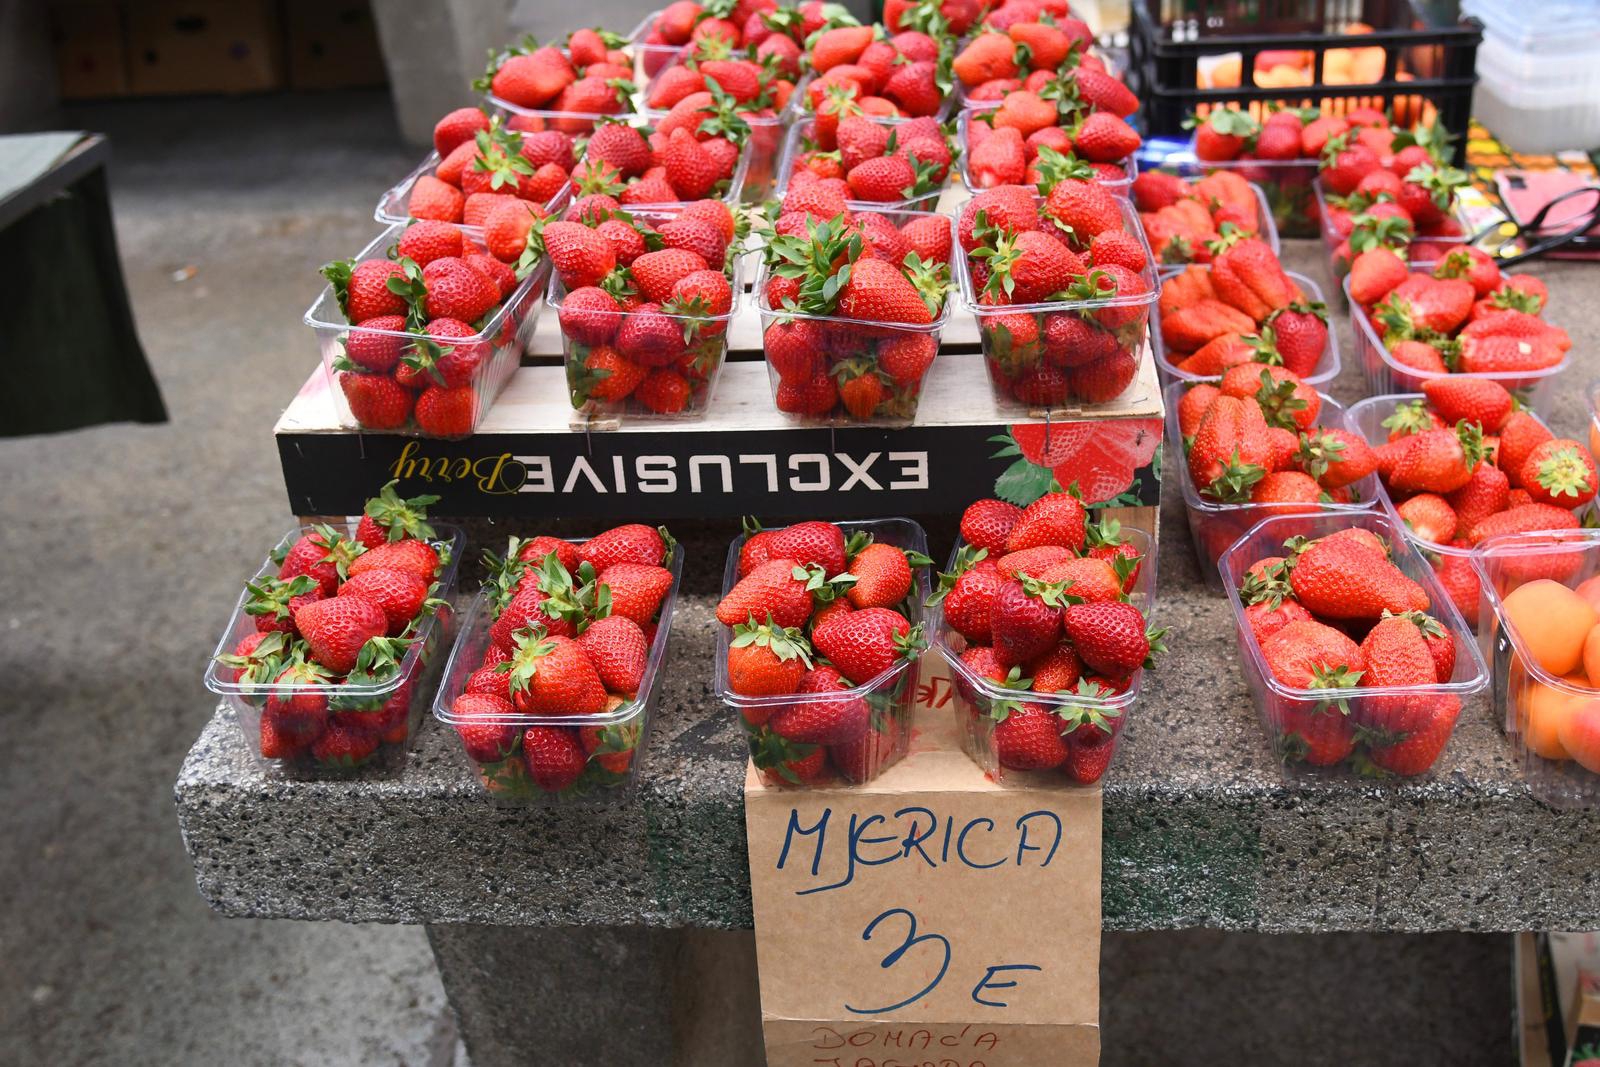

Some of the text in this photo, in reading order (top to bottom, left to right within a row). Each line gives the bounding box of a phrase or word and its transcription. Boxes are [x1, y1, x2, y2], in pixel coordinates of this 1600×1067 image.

[388, 440, 929, 494] EXCLUSIVE Berry
[776, 806, 1062, 895] MJERICA
[845, 908, 951, 1014] 3
